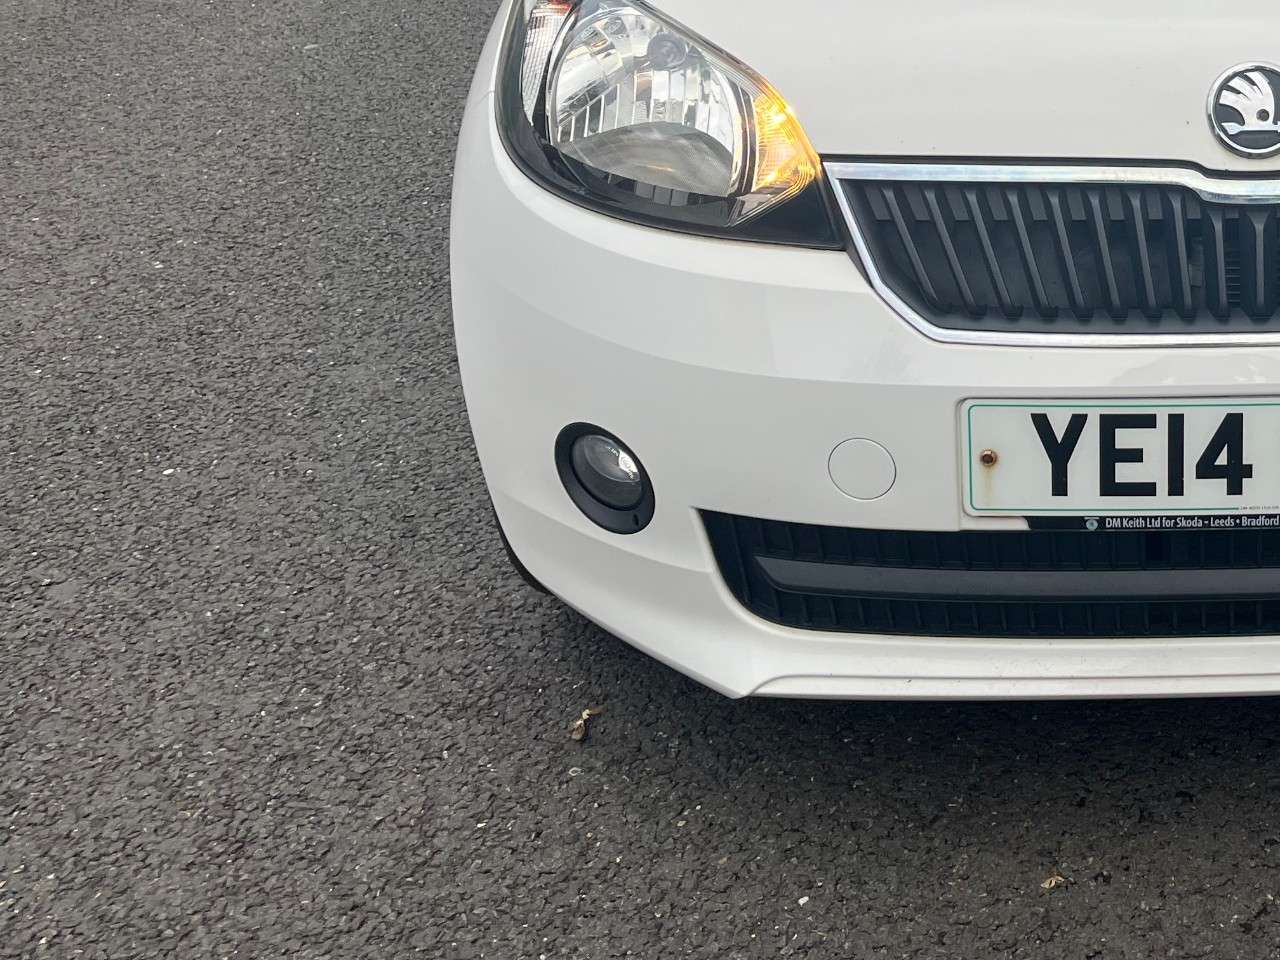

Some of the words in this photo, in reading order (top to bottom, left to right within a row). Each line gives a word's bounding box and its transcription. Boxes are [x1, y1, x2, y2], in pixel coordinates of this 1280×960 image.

[1030, 411, 1254, 497] YE14
[1105, 517, 1121, 528] DM
[1122, 516, 1145, 528] Keith
[1146, 516, 1161, 528] Ltd
[1162, 516, 1175, 528] for
[1177, 515, 1203, 528] Skoda
[1210, 515, 1235, 527] Leeds
[1241, 514, 1280, 527] Bradford
